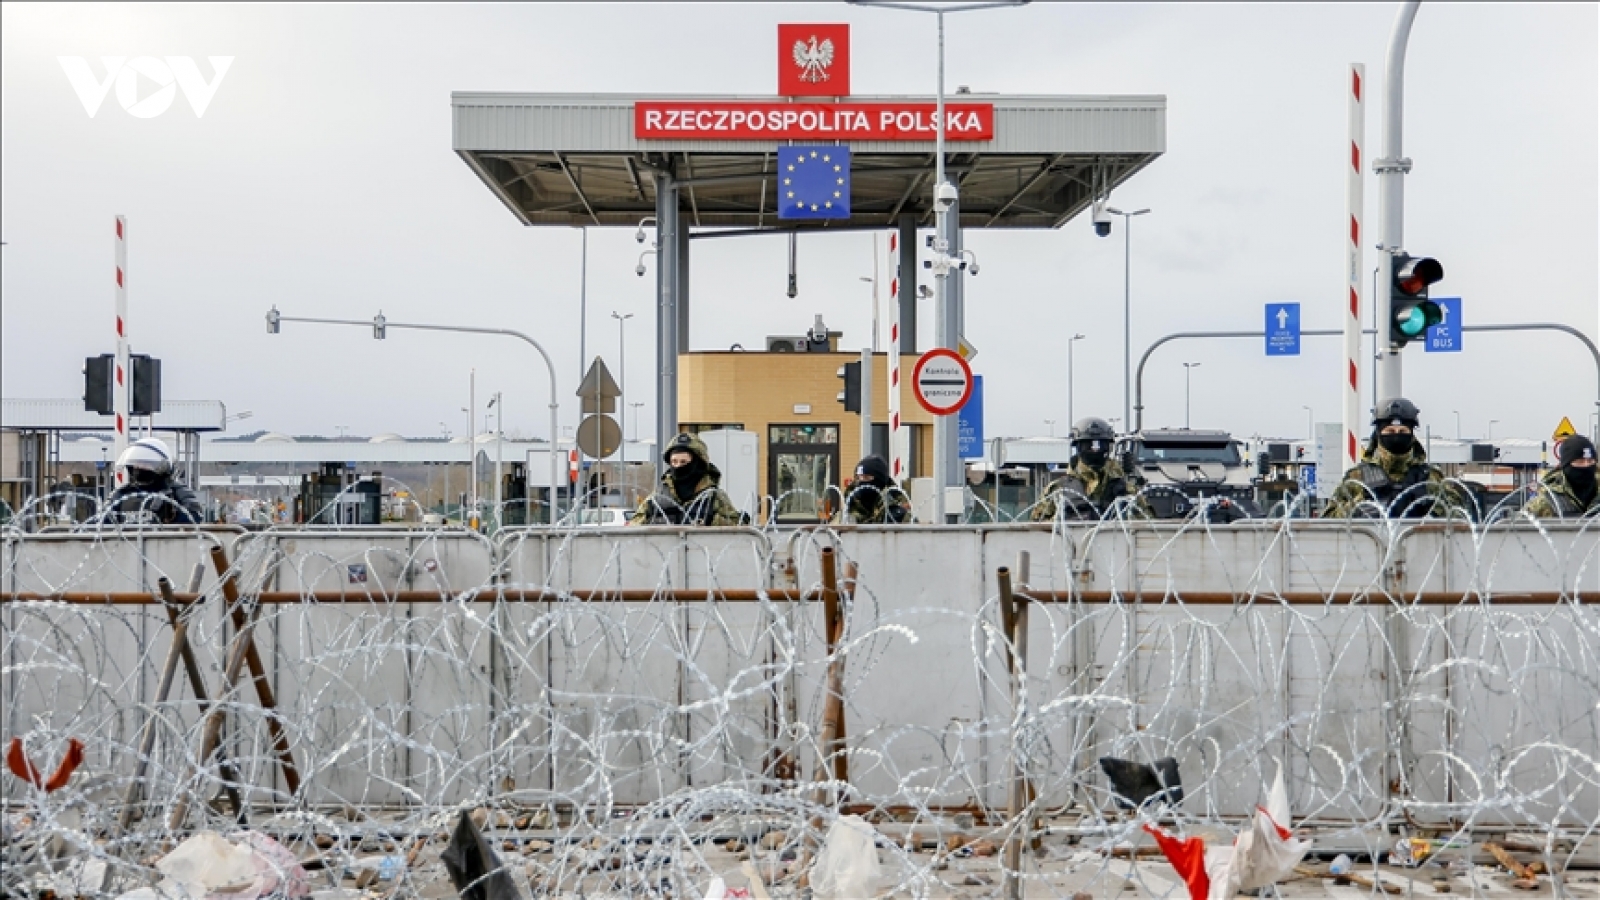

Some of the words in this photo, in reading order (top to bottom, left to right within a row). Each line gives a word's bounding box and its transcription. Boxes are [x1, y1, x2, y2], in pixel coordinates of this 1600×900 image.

[645, 110, 870, 132] RZECZPOSPOLITA
[1436, 327, 1449, 336] PC
[1432, 338, 1453, 348] BUS
[925, 367, 959, 375] Kontrola
